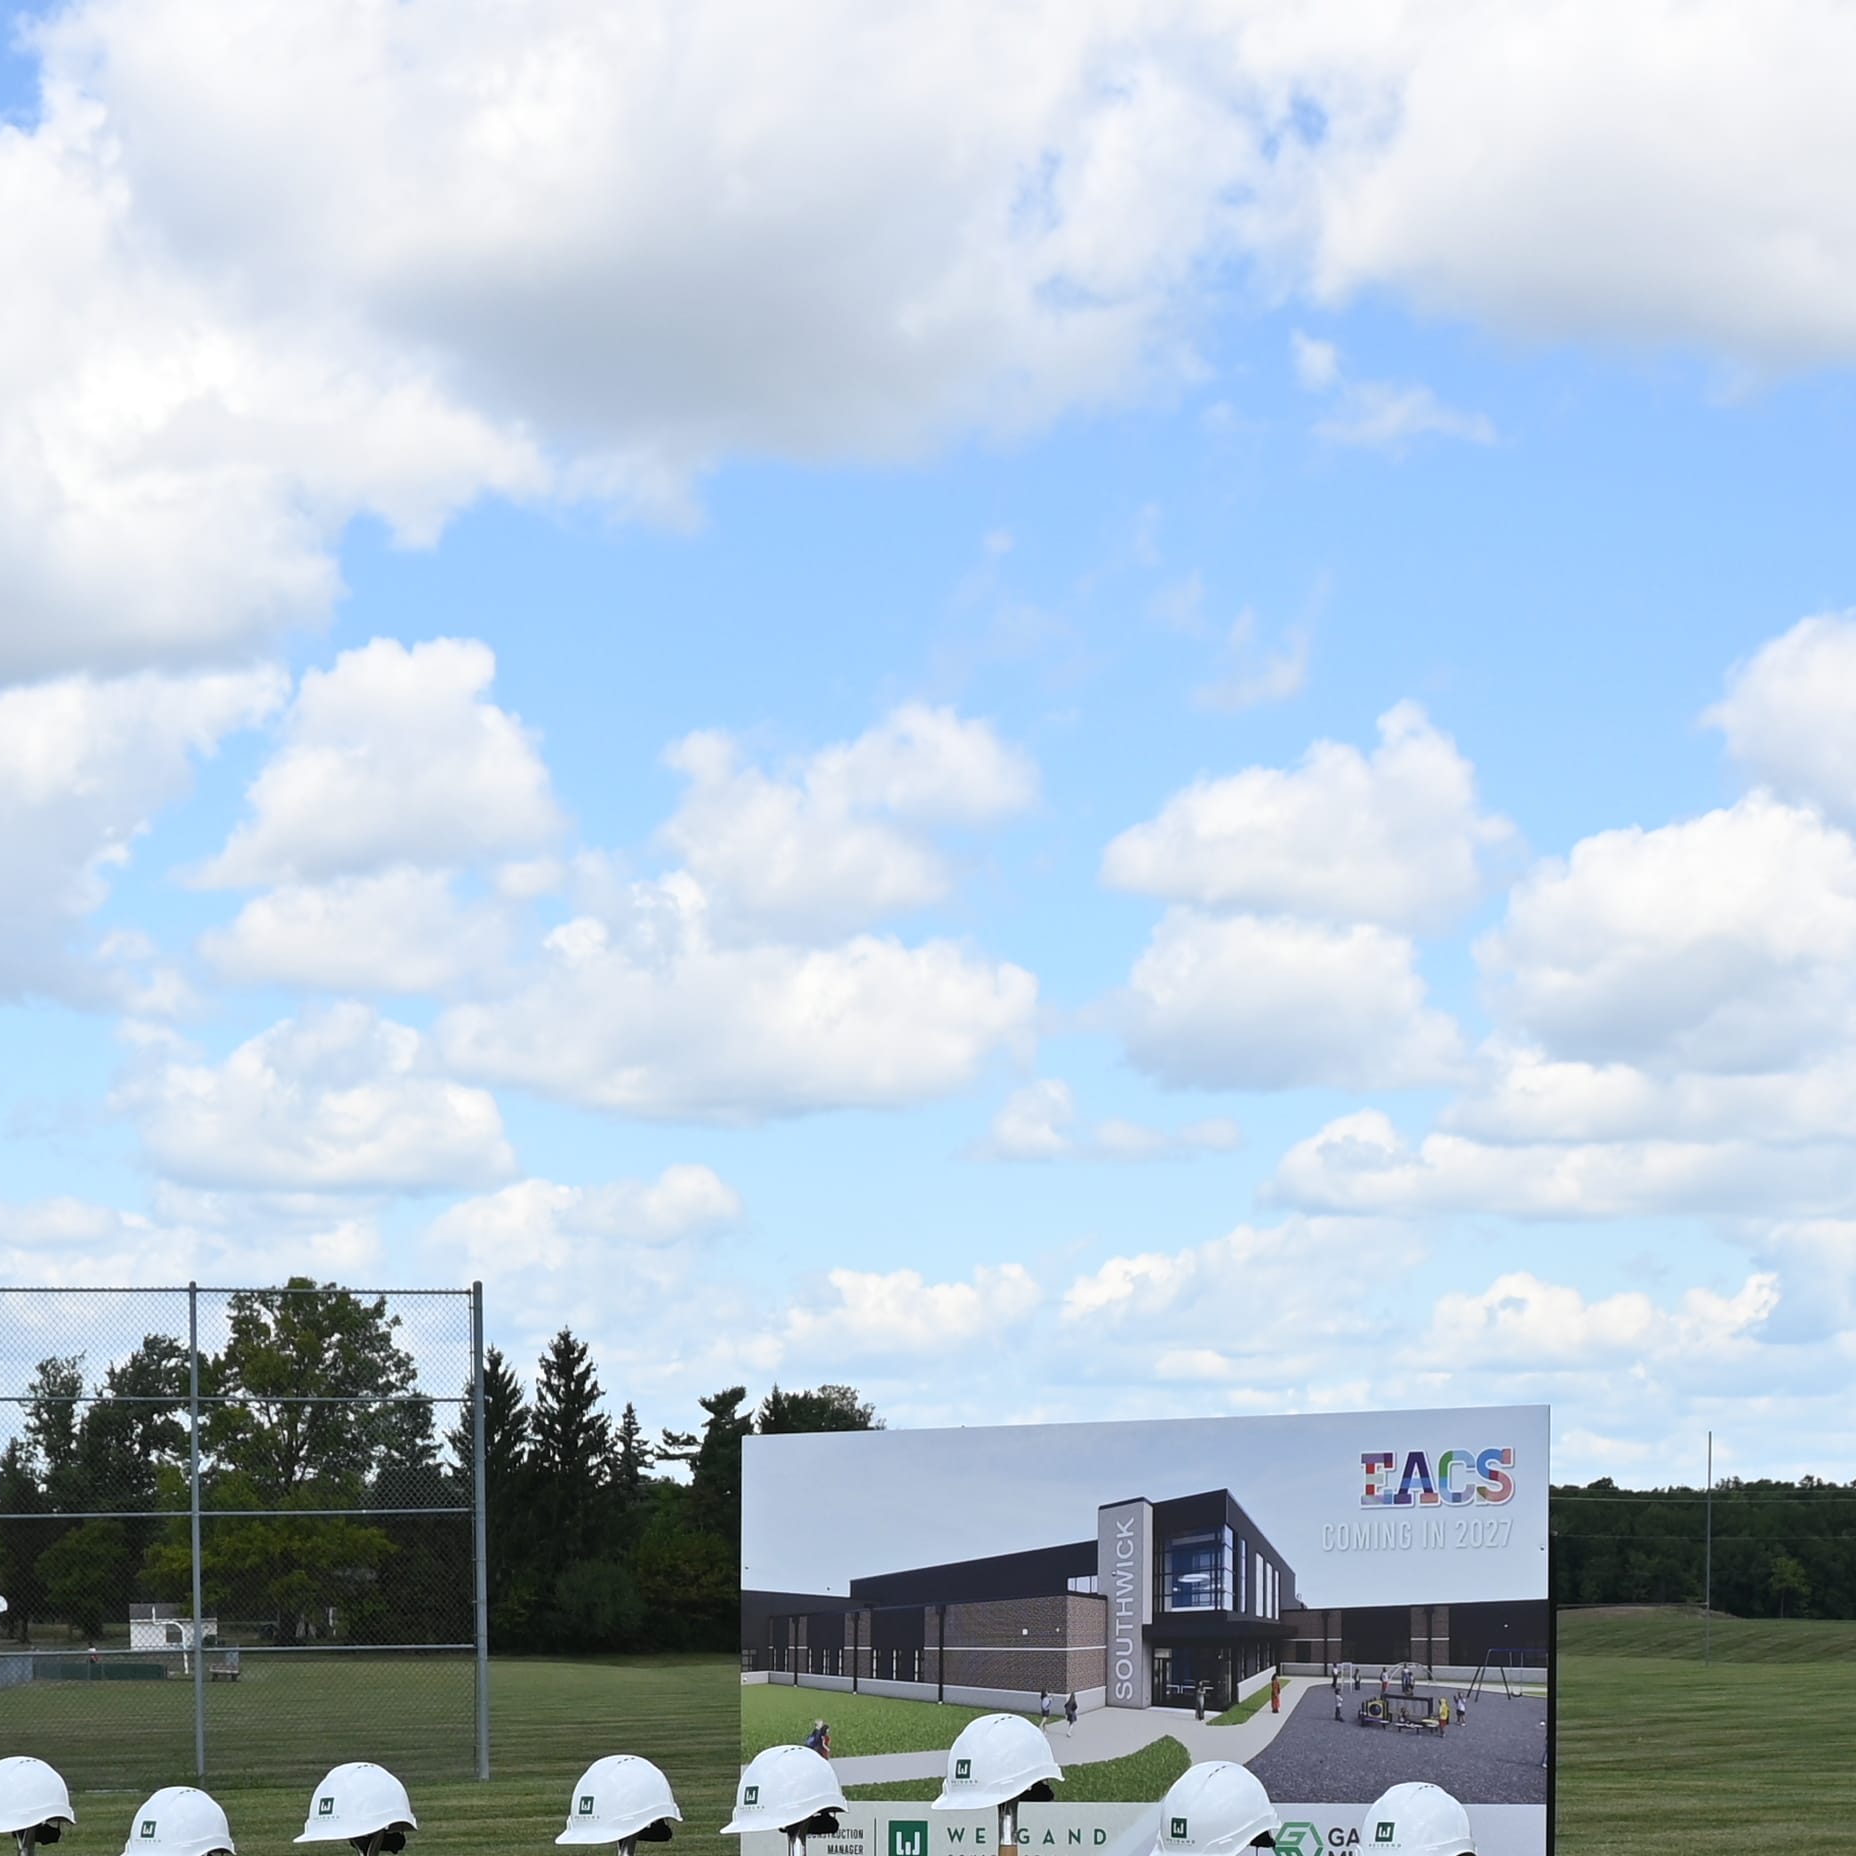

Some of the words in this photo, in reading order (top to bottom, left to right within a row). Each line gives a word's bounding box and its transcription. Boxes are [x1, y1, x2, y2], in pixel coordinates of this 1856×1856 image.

[1361, 1447, 1514, 1509] EACS
[1322, 1521, 1413, 1551] COMING
[1423, 1520, 1446, 1549] IN
[1456, 1519, 1514, 1549] 2027
[1116, 1517, 1134, 1699] SOUTHWICK
[807, 1829, 864, 1839] RUCTION
[947, 1827, 1107, 1845] WEGAND
[827, 1845, 864, 1855] MANAGER
